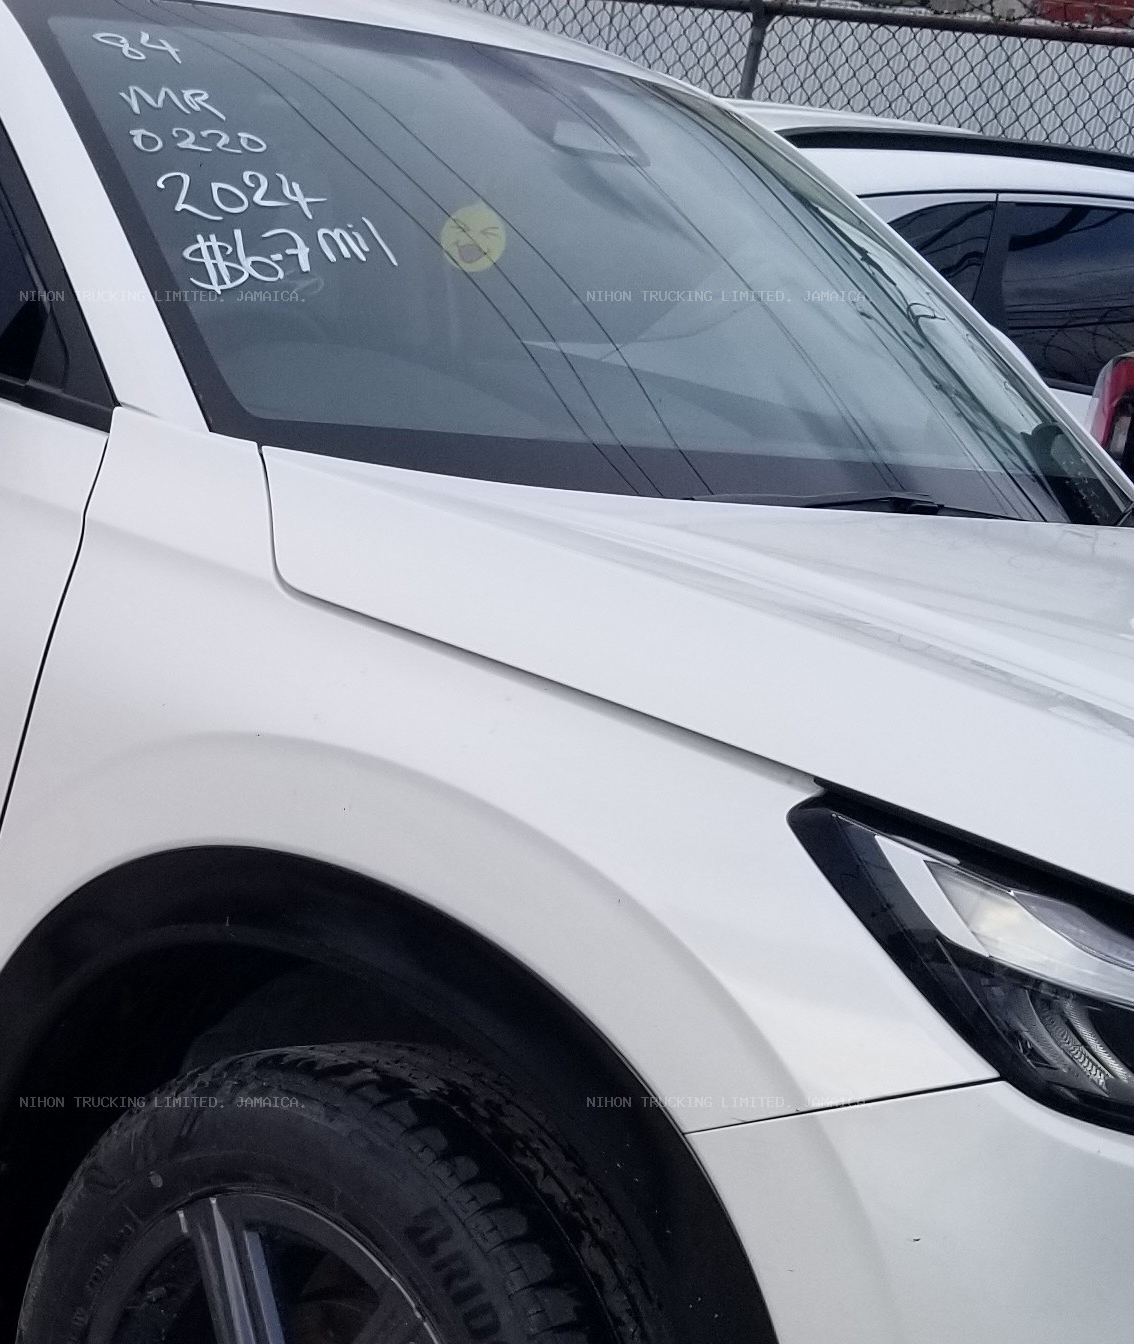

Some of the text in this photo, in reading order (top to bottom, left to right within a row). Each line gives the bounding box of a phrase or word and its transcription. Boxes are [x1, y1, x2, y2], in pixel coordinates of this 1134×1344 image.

[93, 31, 181, 63] 84
[119, 85, 226, 121] MR
[129, 127, 267, 154] 0220
[156, 170, 328, 220] 2024
